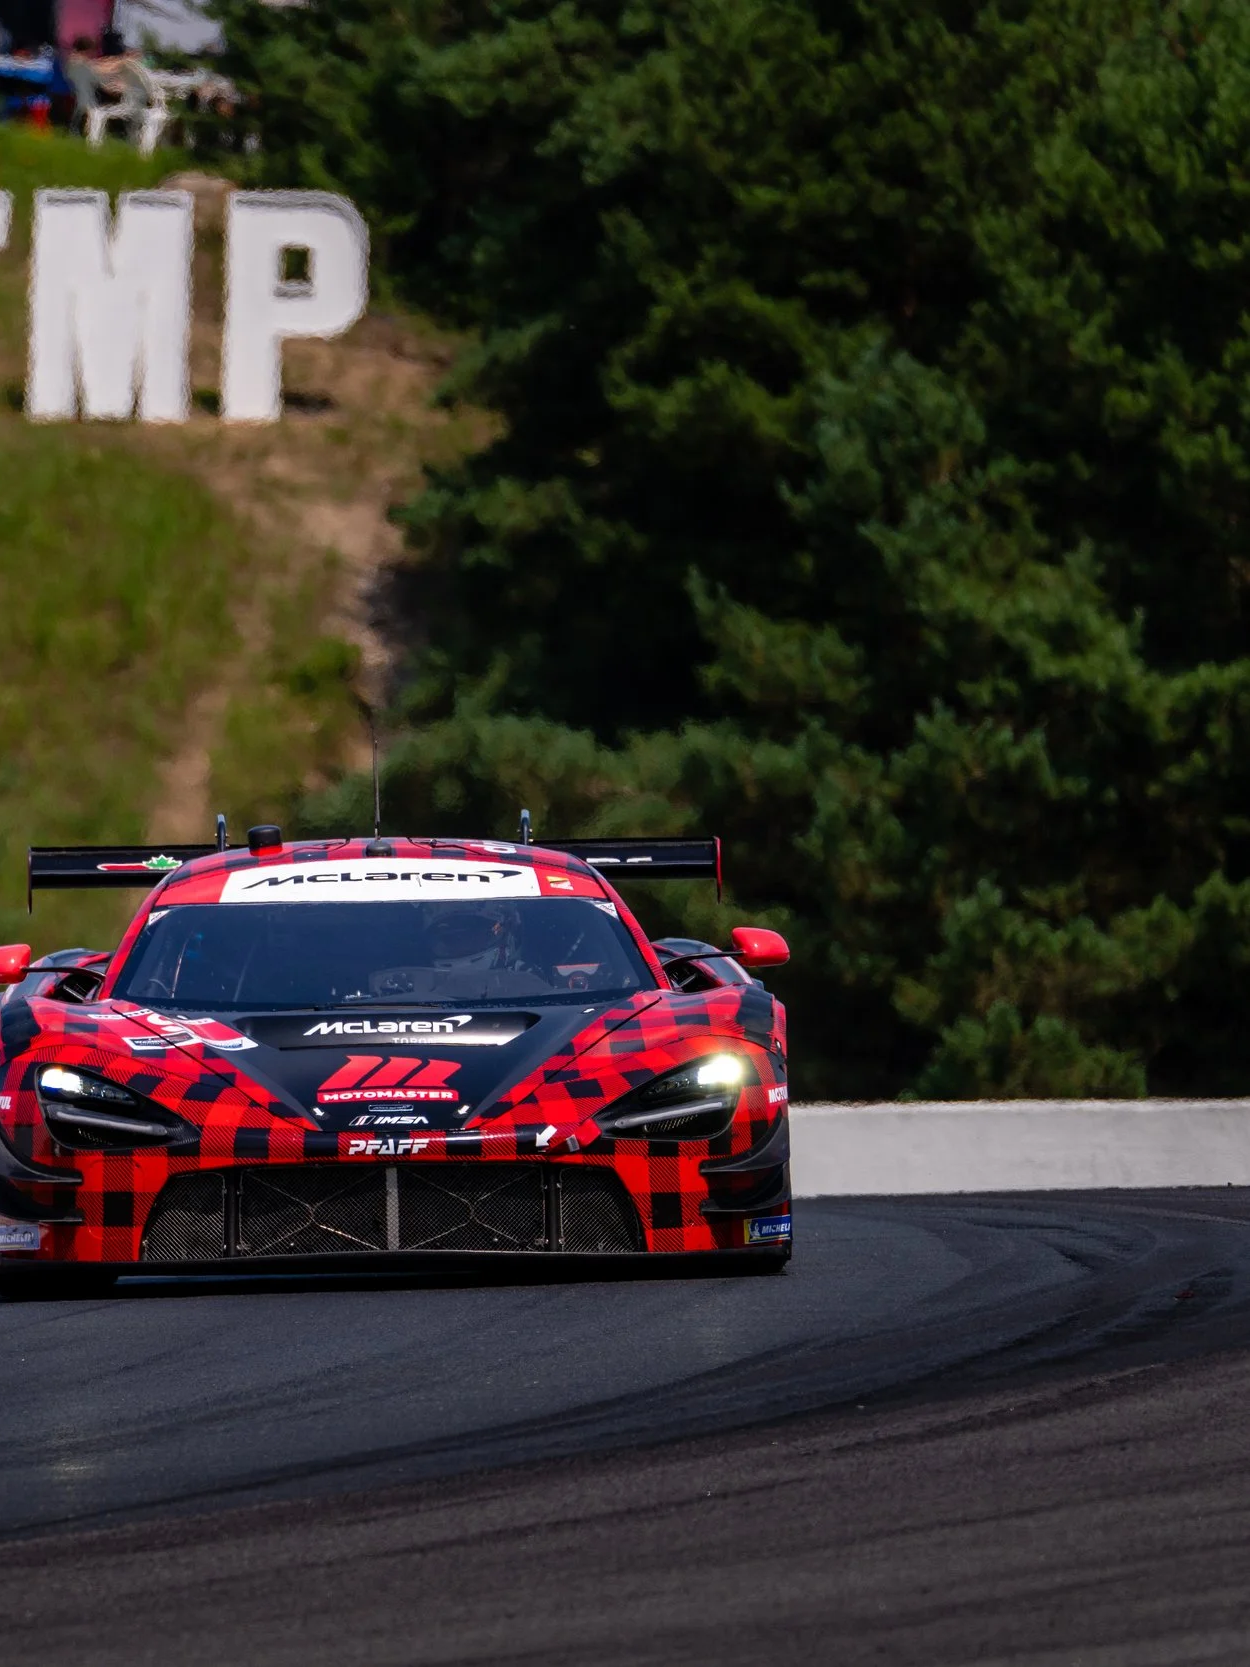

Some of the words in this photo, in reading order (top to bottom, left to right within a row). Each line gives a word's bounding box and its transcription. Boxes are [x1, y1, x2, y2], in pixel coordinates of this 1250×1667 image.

[241, 870, 500, 890] McLaren
[303, 1018, 458, 1036] McLaren
[323, 1091, 454, 1102] MOTOMASTER
[373, 1115, 430, 1125] IMSA
[348, 1138, 431, 1155] PFAFF
